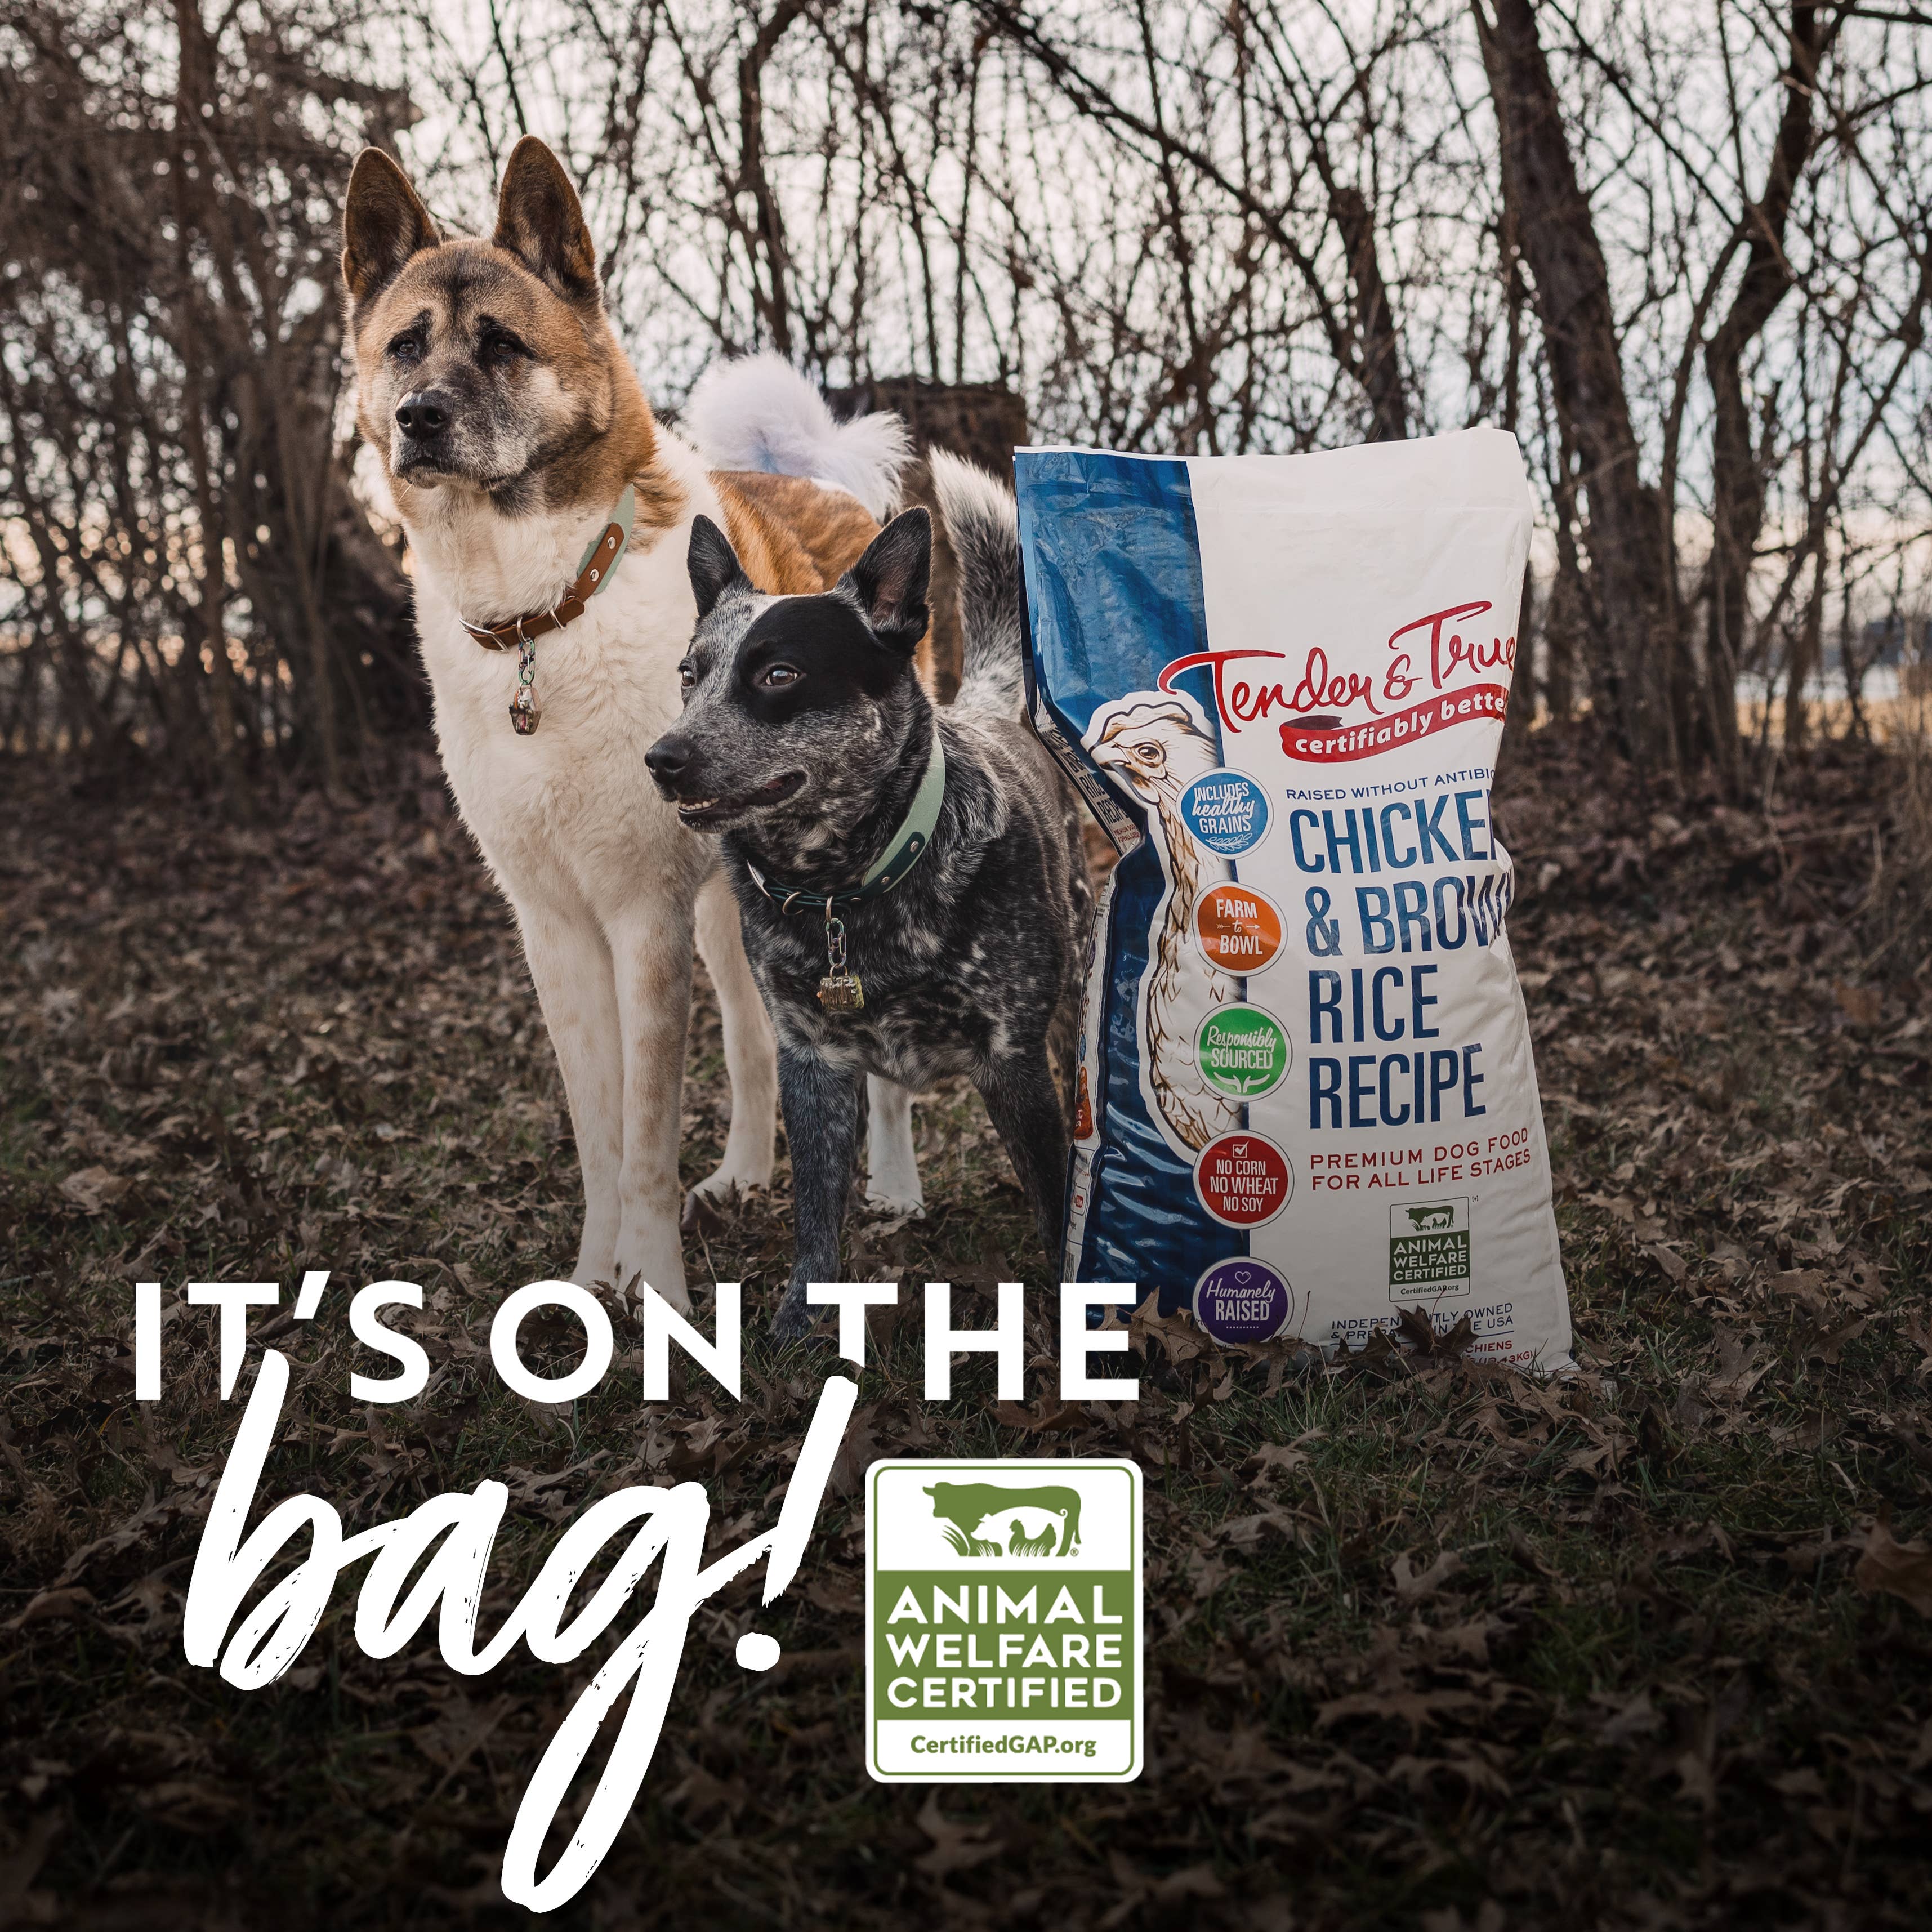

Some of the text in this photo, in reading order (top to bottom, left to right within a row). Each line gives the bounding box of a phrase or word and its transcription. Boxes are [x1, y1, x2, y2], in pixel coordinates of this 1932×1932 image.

[1158, 601, 1515, 733] Tender & True
[1295, 693, 1506, 753] certifiably bette
[1193, 782, 1250, 801] INCLUDES
[1286, 788, 1346, 800] RAISED
[1351, 777, 1429, 798] WITHOUT
[1192, 792, 1255, 820] healthy
[1199, 815, 1251, 834] GRAINS
[1289, 789, 1497, 875] CHICKE
[1216, 899, 1257, 919] FARM
[1305, 873, 1511, 957] & BROW
[1232, 920, 1243, 933] to
[1220, 935, 1263, 955] BOWL
[1309, 963, 1439, 1044] RICE
[1207, 1025, 1277, 1054] Responsibly
[1211, 1048, 1273, 1069] SOURCED
[1309, 1042, 1487, 1130] RECIPE
[1310, 1127, 1528, 1169] PREMIUM DOG FOOD
[1216, 1159, 1266, 1175] NO CORN
[1312, 1148, 1531, 1190] FOR ALL LIFE STAGES
[1210, 1176, 1279, 1195] NO WHEAT
[1223, 1196, 1264, 1212] NO SOY
[1394, 1235, 1467, 1255] ANIMAL
[1393, 1250, 1467, 1268] WELFARE
[1393, 1264, 1467, 1281] CERTIFIED
[1206, 1278, 1276, 1303] Humanely
[1215, 1300, 1270, 1321] RAISED
[1332, 1311, 1459, 1329] INDEPENTLY
[1465, 1302, 1513, 1319] OWNED
[1487, 1315, 1514, 1328] USA
[1465, 1340, 1512, 1353] CHIENS
